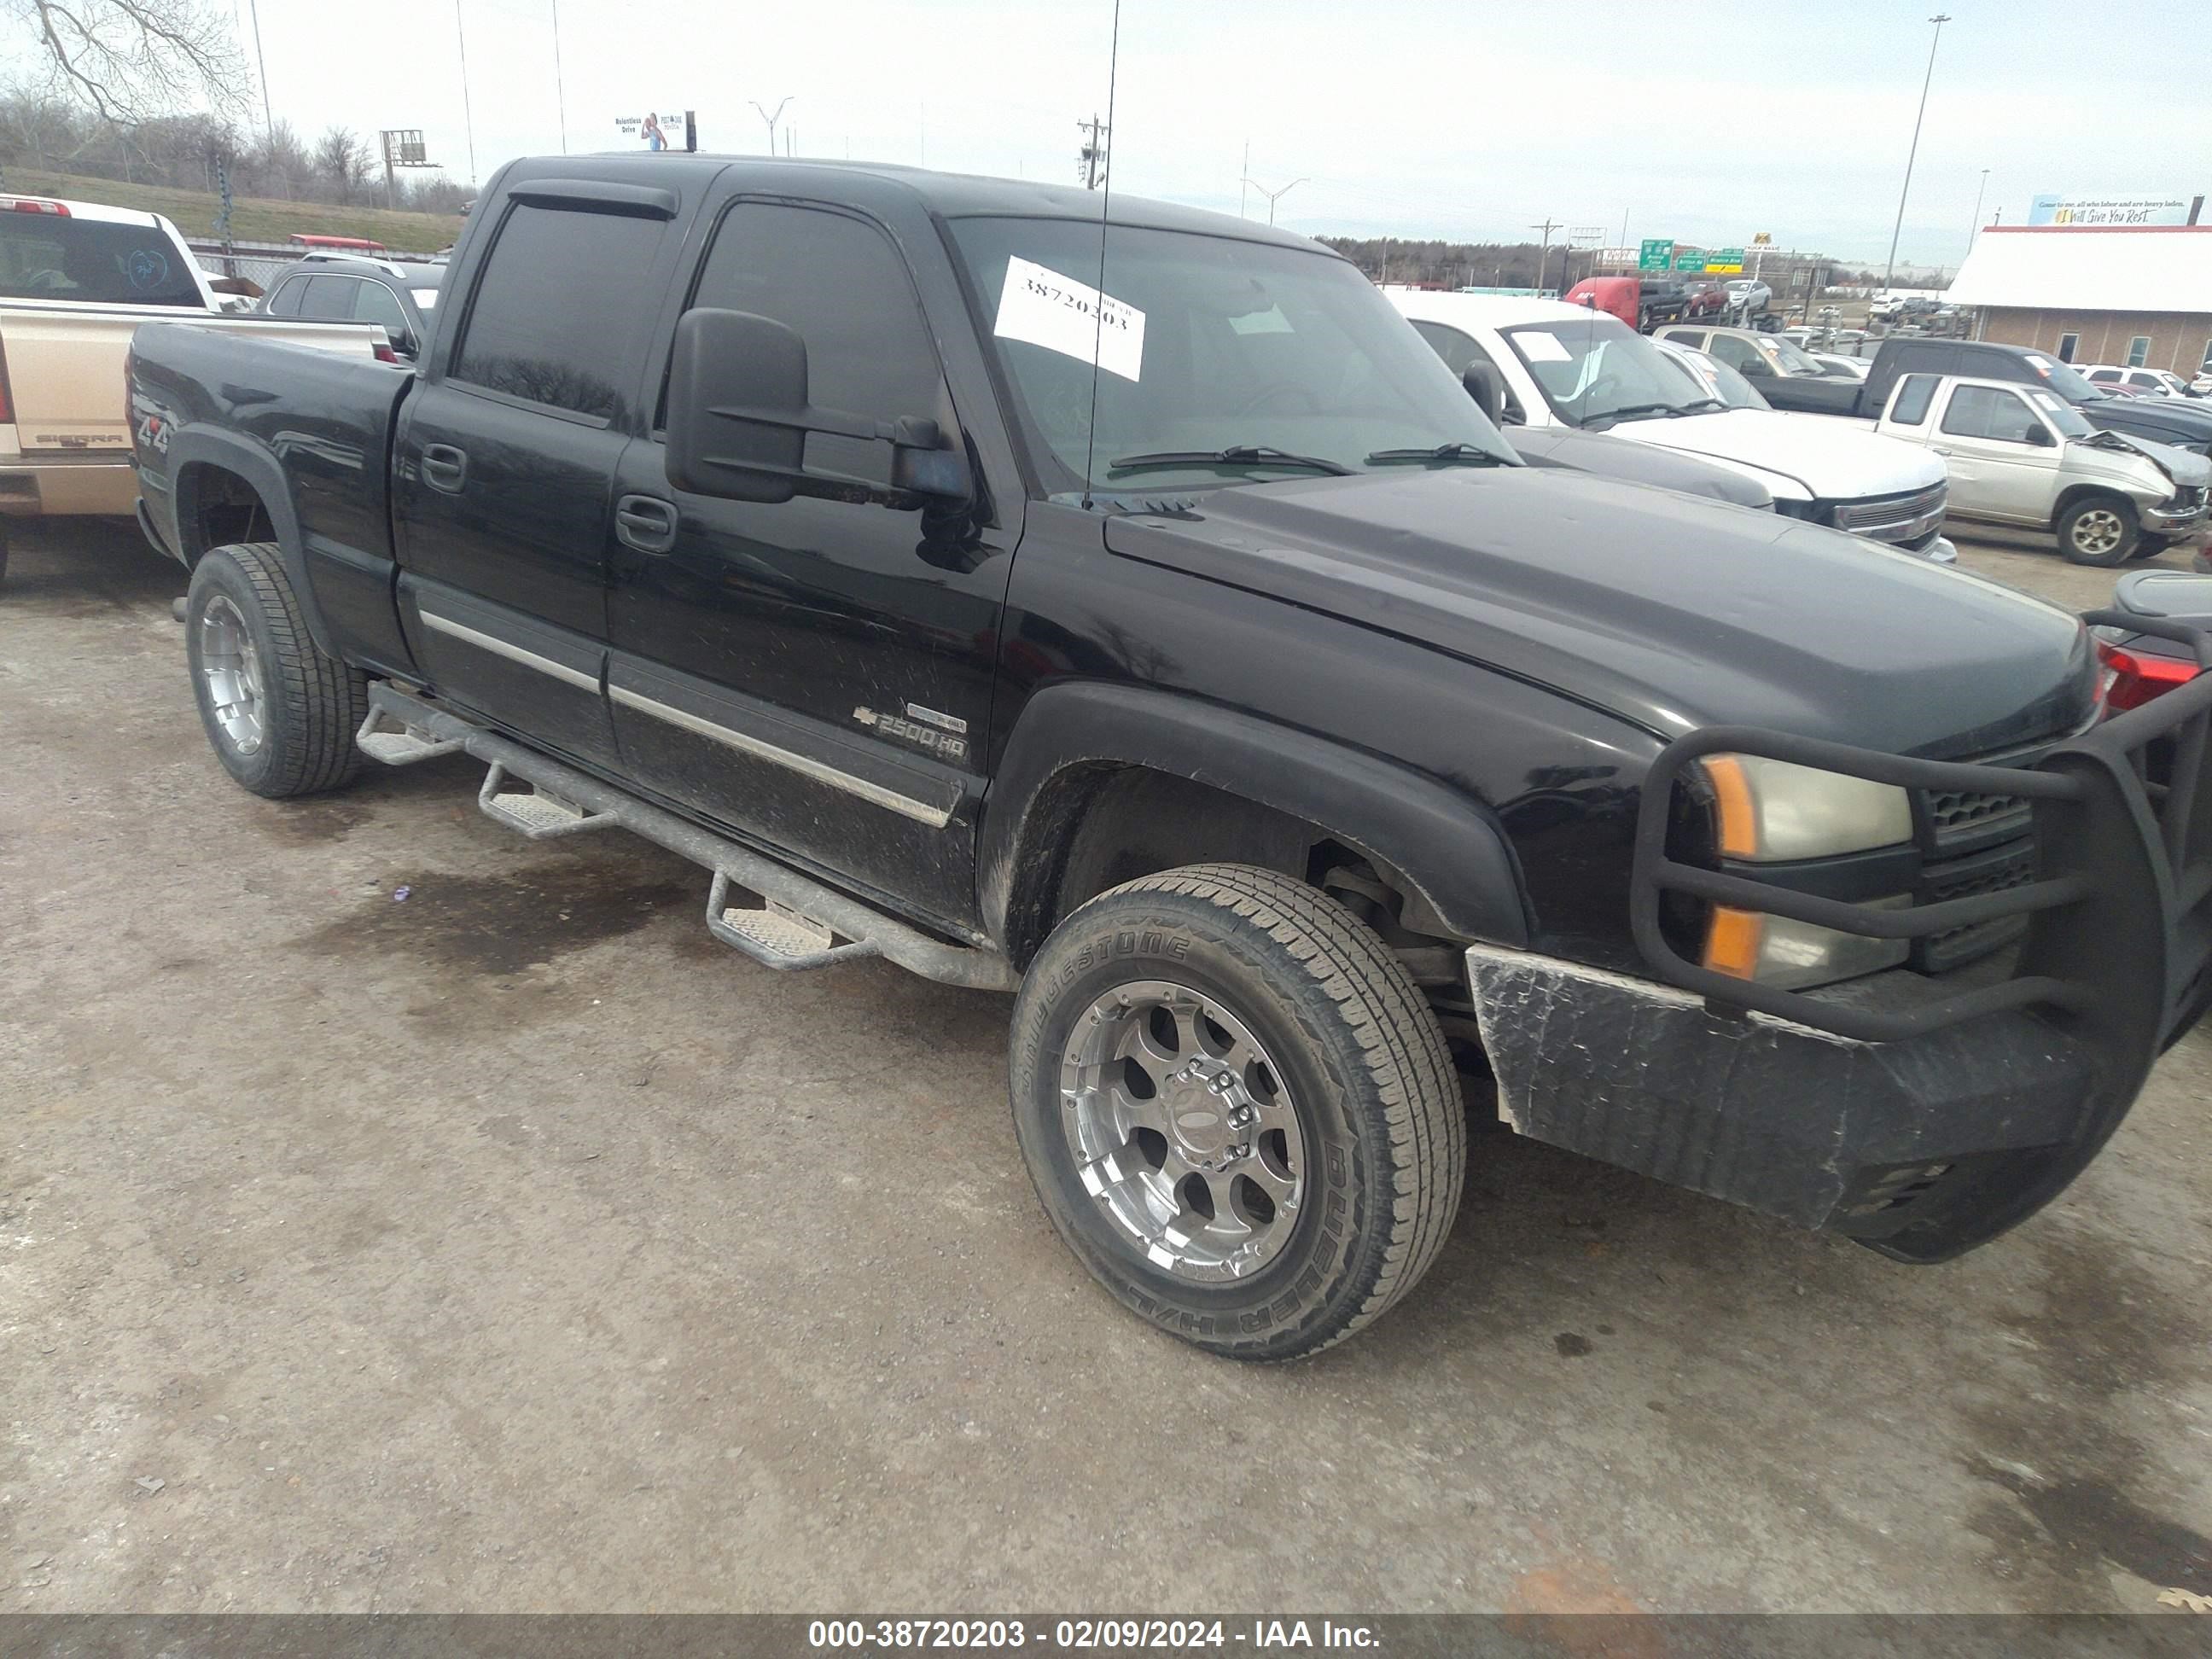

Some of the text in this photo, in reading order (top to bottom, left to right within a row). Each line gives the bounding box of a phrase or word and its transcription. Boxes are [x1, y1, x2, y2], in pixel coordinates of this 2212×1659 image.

[2069, 209, 2087, 223] Will
[2087, 209, 2106, 223] Give
[2108, 209, 2124, 223] You
[1021, 278, 1127, 330] 38720203
[35, 434, 124, 444] SIERRA
[1240, 1140, 1347, 1334] DUELER
